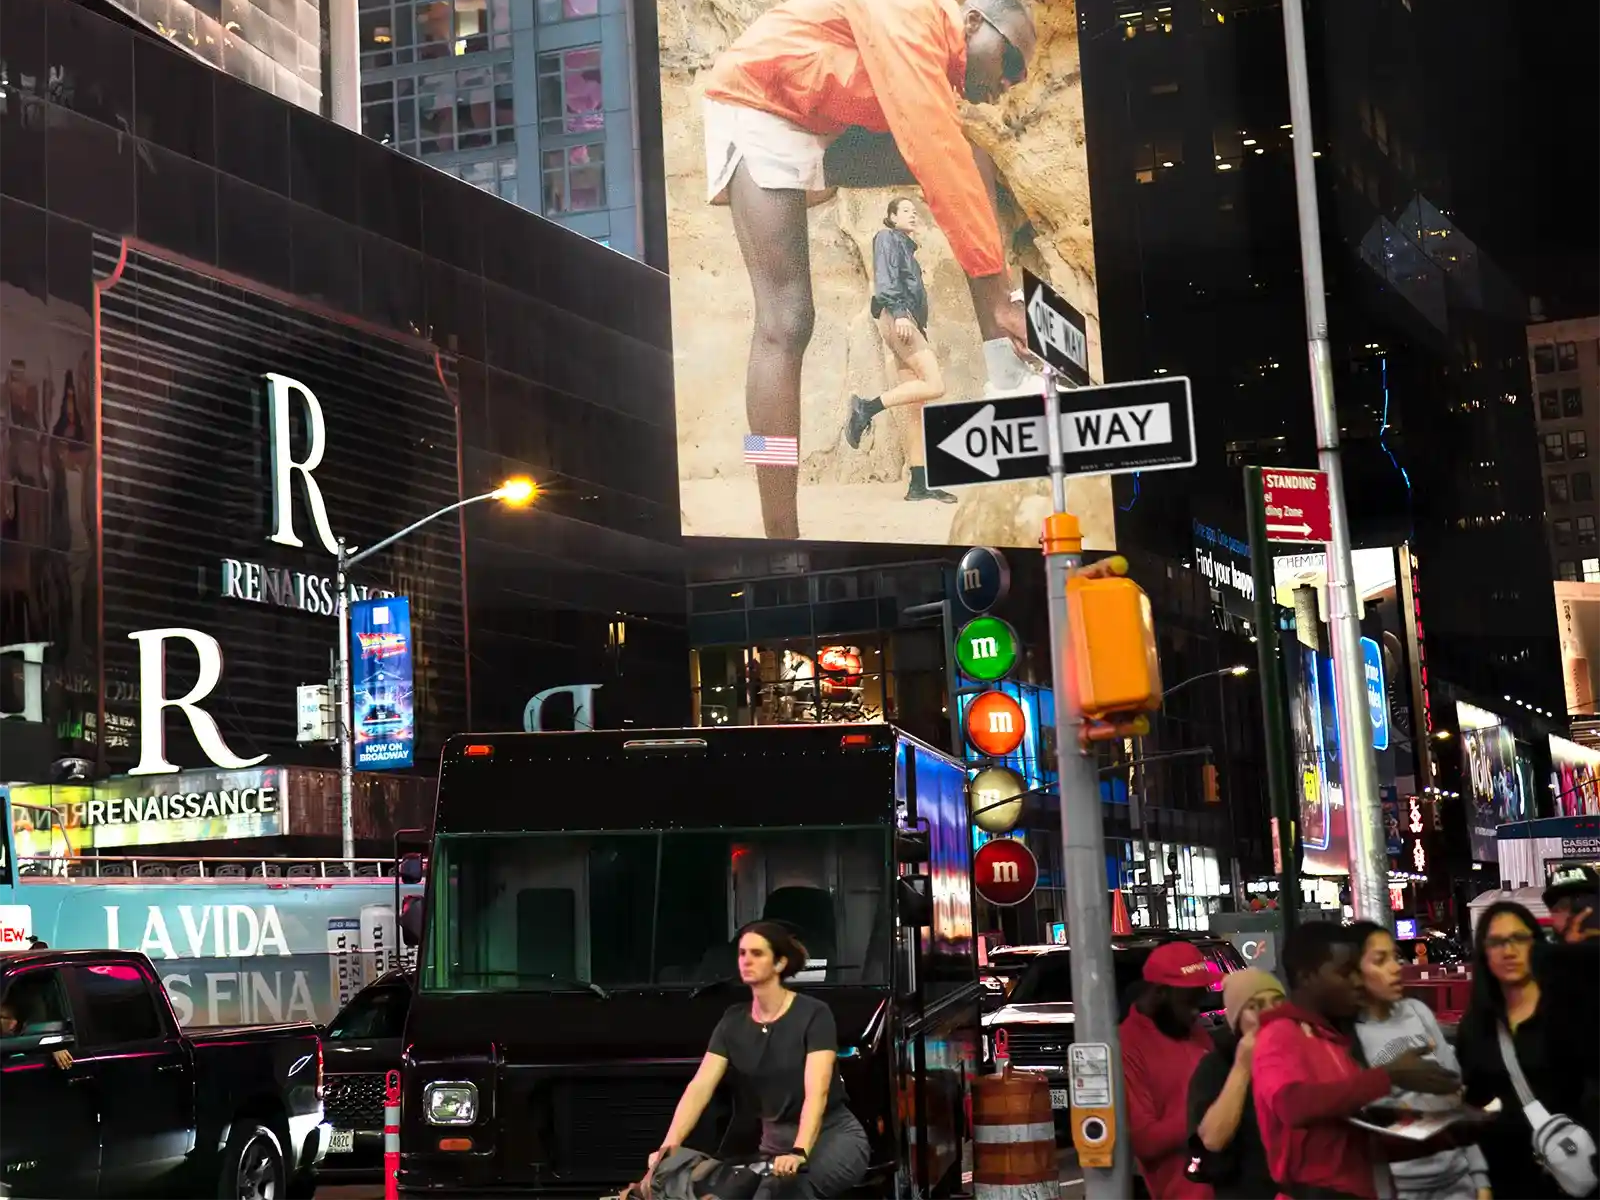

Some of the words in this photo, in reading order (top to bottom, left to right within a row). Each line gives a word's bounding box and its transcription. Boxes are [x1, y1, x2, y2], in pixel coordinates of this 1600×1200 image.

[1035, 301, 1056, 343] ONE
[965, 421, 1039, 459] ONE
[1074, 409, 1154, 447] WAY
[265, 372, 359, 556] R
[1266, 474, 1317, 490] STANDING
[1283, 505, 1304, 518] Zone
[963, 567, 982, 591] m
[1195, 547, 1213, 578] Find
[1214, 560, 1231, 588] your
[970, 637, 1000, 660] m
[128, 628, 271, 776] R
[988, 710, 1014, 733] m
[359, 749, 409, 762] BROADWAY
[365, 743, 388, 754] NOW
[388, 742, 403, 751] ON
[87, 787, 276, 825] RENAISSANCE
[991, 860, 1019, 883] m
[103, 905, 179, 959] LA
[177, 904, 292, 958] VIDA
[205, 970, 317, 1025] FINA
